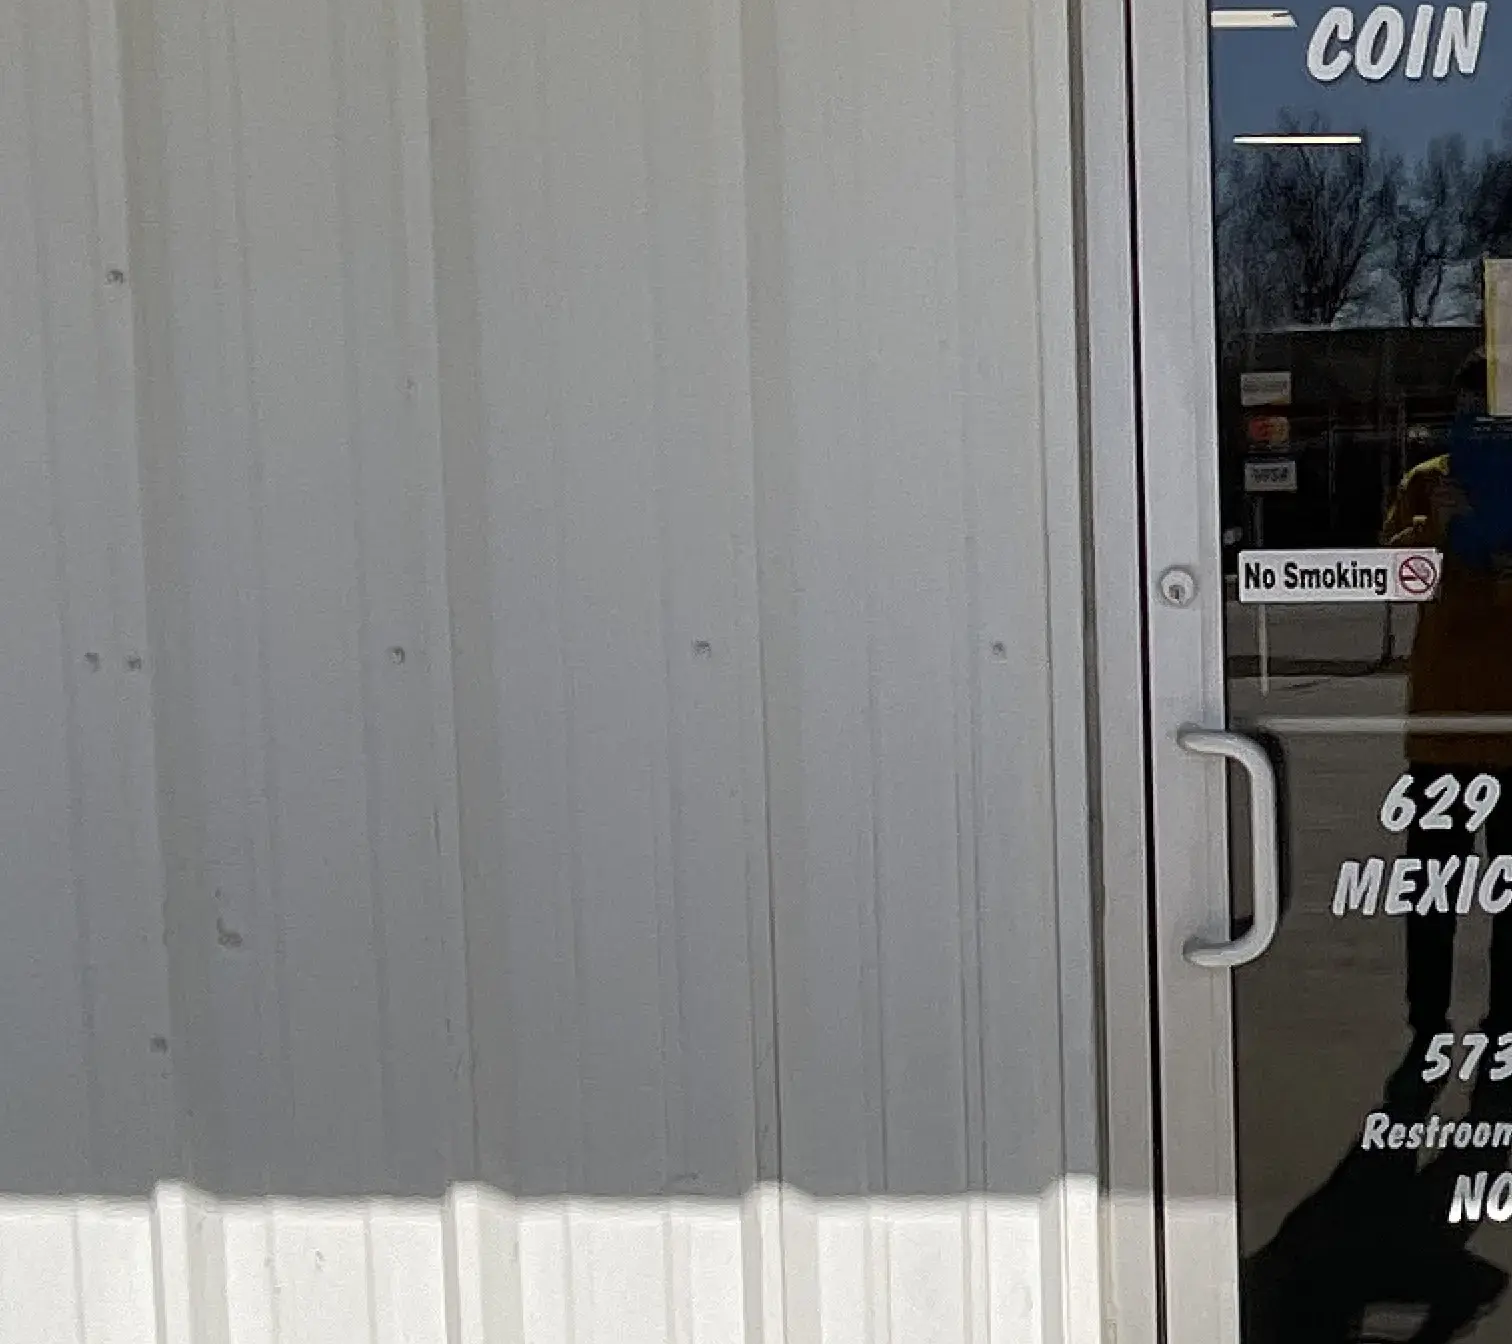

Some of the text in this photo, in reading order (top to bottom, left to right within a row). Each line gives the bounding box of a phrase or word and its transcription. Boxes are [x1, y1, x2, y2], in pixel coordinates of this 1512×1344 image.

[1306, 0, 1488, 81] COIN
[1244, 561, 1388, 596] No Smoking
[1380, 773, 1501, 832] 629
